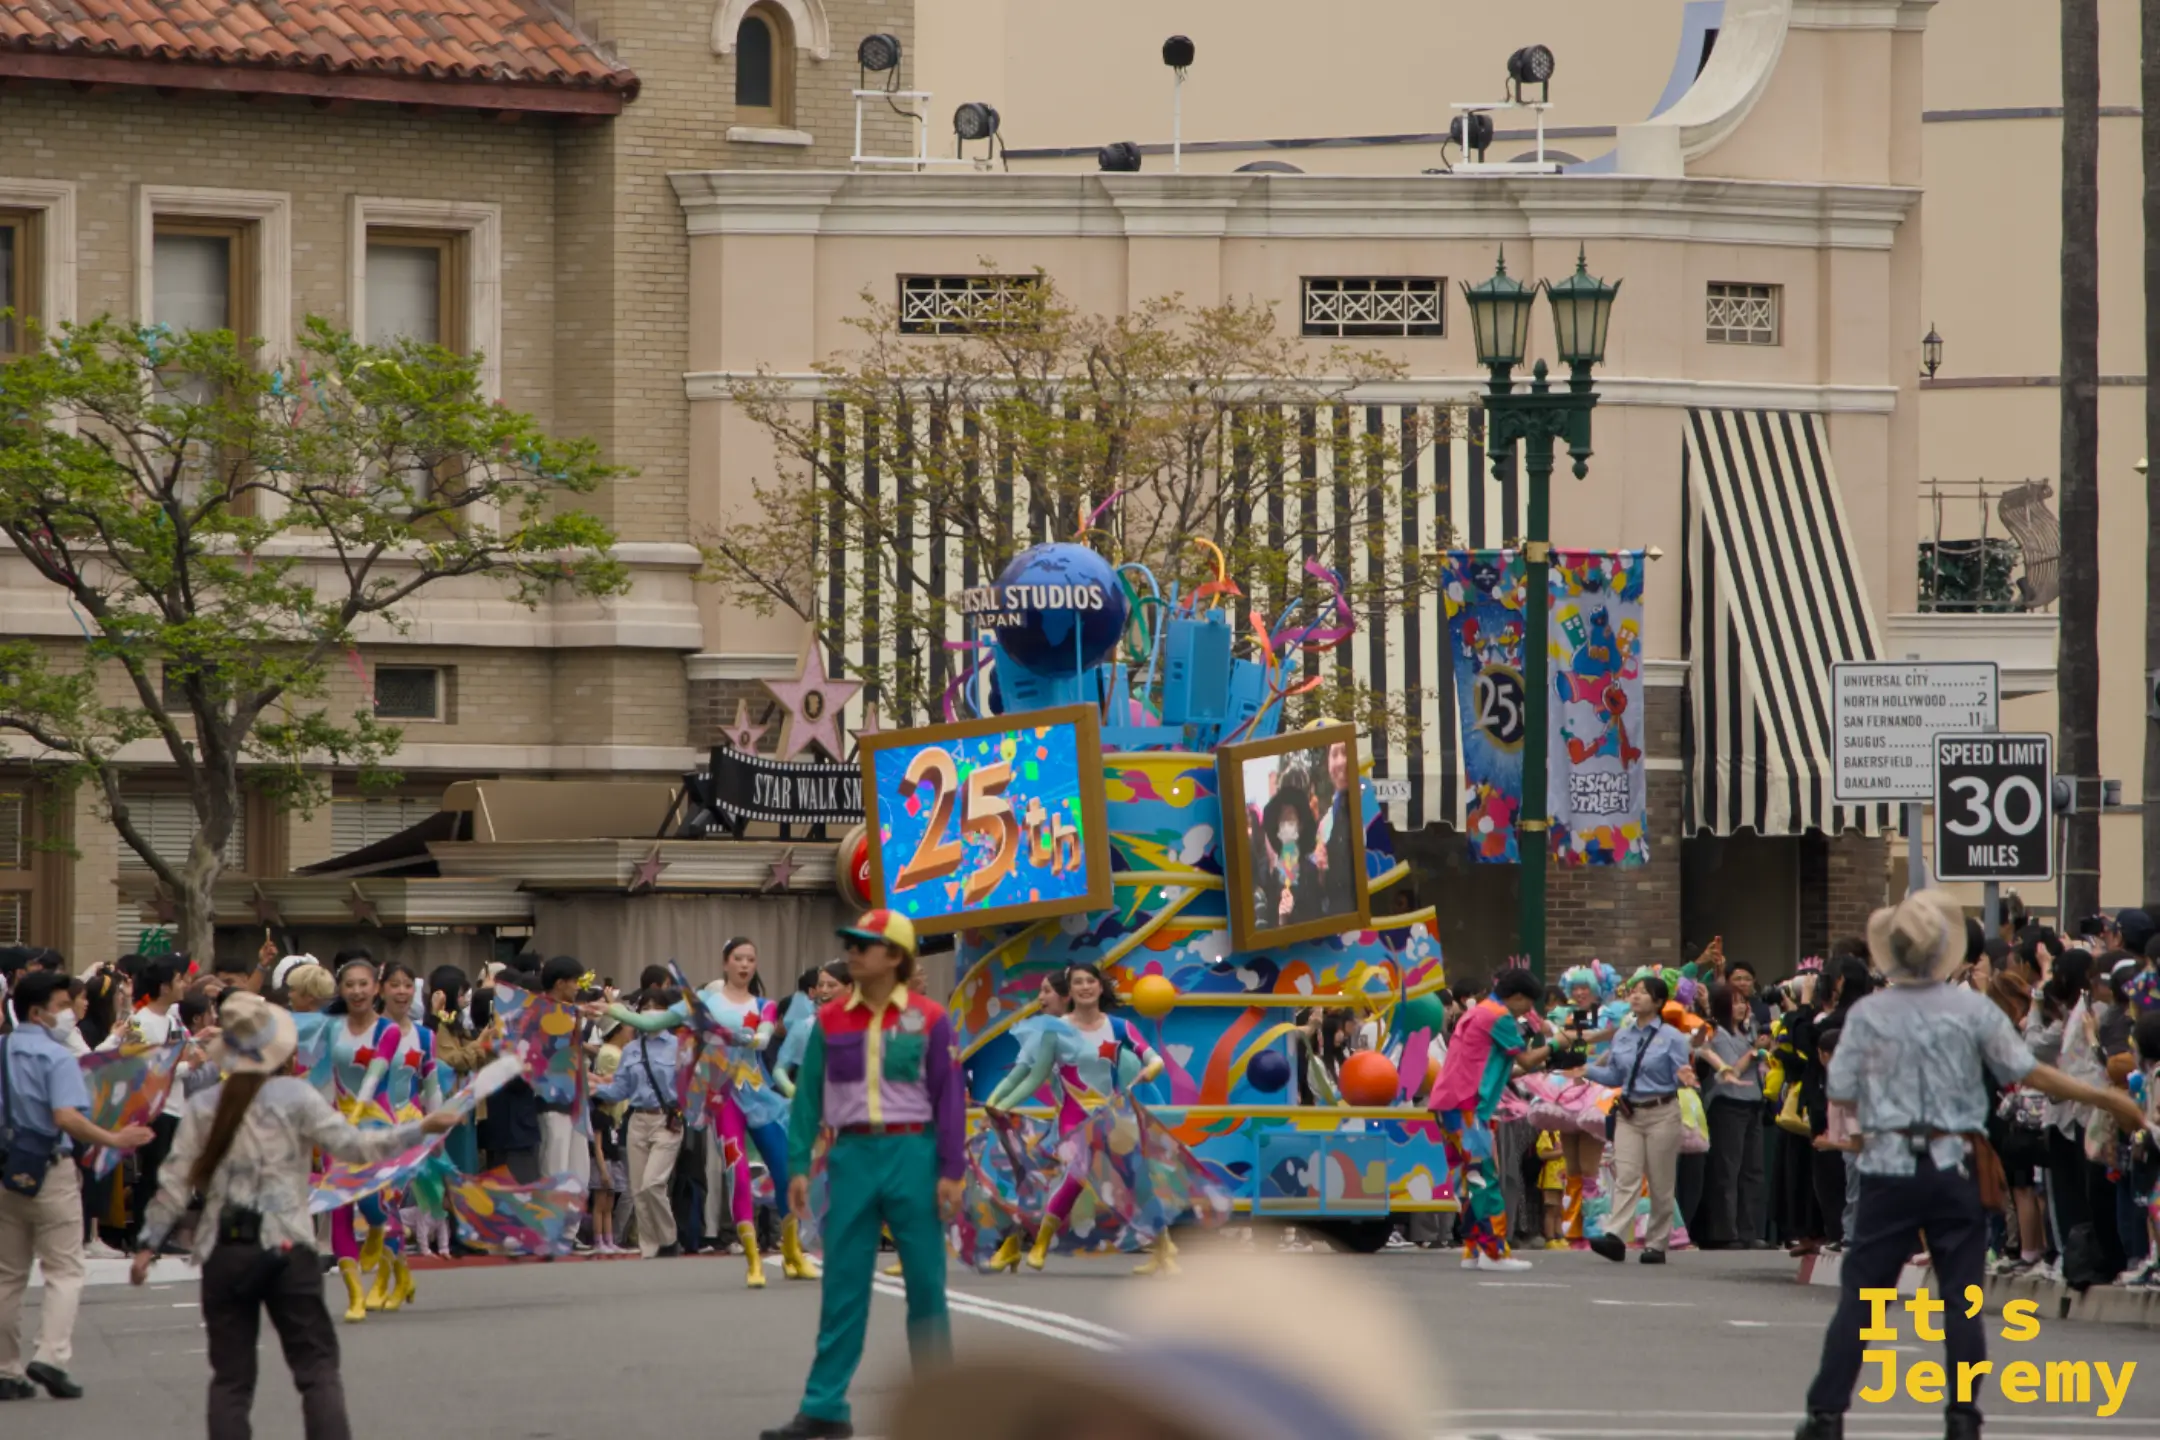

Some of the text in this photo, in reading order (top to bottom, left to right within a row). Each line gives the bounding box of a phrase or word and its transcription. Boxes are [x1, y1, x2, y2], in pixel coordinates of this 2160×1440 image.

[1004, 585, 1103, 610] STUDIOS
[1843, 674, 1929, 687] UNIVERSAL CITY
[1843, 691, 1988, 707] NORTH HOLLYWOOD 2
[1843, 716, 1864, 728] SAN
[1867, 715, 1922, 727] FERNANDO
[1843, 736, 1887, 748] SAUGUS
[1843, 756, 1913, 768] BAKERSFIELD
[1940, 743, 2045, 765] SPEED LIMIT
[753, 773, 866, 810] STAR WALK SN
[1569, 771, 1629, 792] SESAME
[1843, 776, 1892, 789] OAKLAND
[1570, 791, 1629, 815] STREET
[1945, 775, 2042, 836] 30
[893, 747, 1083, 906] 25th
[1967, 844, 2020, 867] MILES
